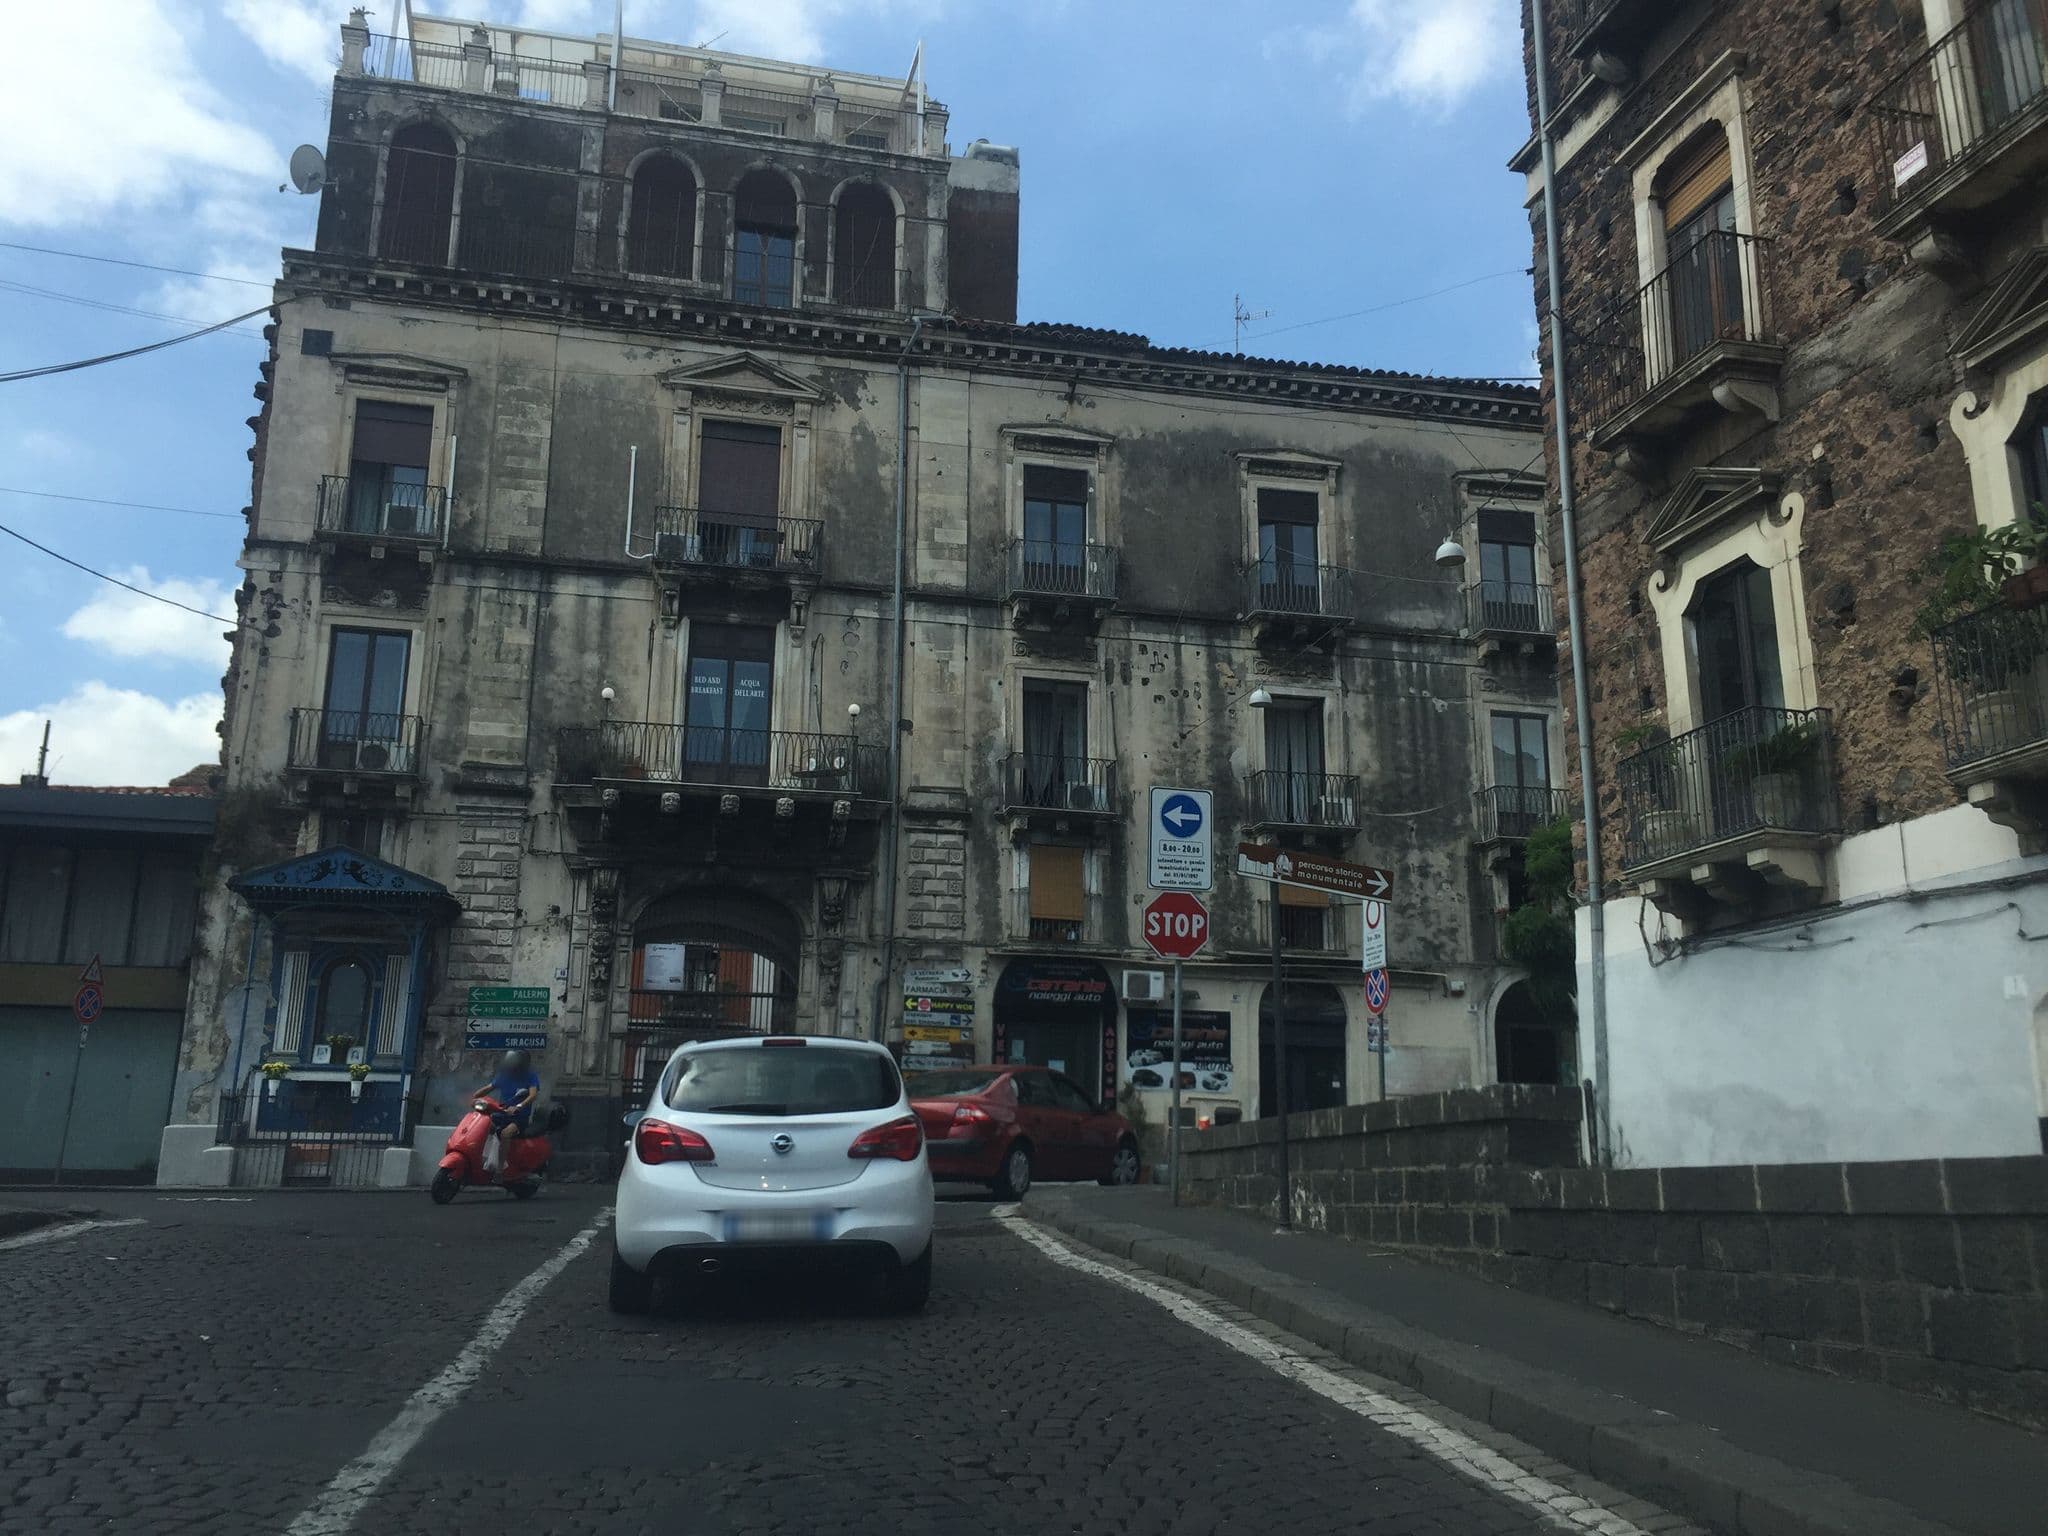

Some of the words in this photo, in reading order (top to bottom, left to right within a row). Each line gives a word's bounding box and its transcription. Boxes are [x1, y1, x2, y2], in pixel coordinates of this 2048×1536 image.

[694, 675, 707, 684] BED
[708, 676, 721, 684] AND
[740, 679, 761, 689] ACQUA
[690, 686, 724, 695] BREAKFAST
[1298, 861, 1335, 874] percorso
[1335, 867, 1364, 880] storico
[1297, 870, 1364, 889] monumentale
[1147, 911, 1206, 938] STOP
[905, 984, 948, 994] FARMACIA
[513, 990, 548, 1000] PALERMO
[1028, 991, 1071, 1002] noleggi
[1073, 992, 1102, 1002] auto
[500, 1006, 546, 1015] MESSINA
[509, 1023, 546, 1031] aeroporto
[505, 1038, 546, 1048] SIRACUSA
